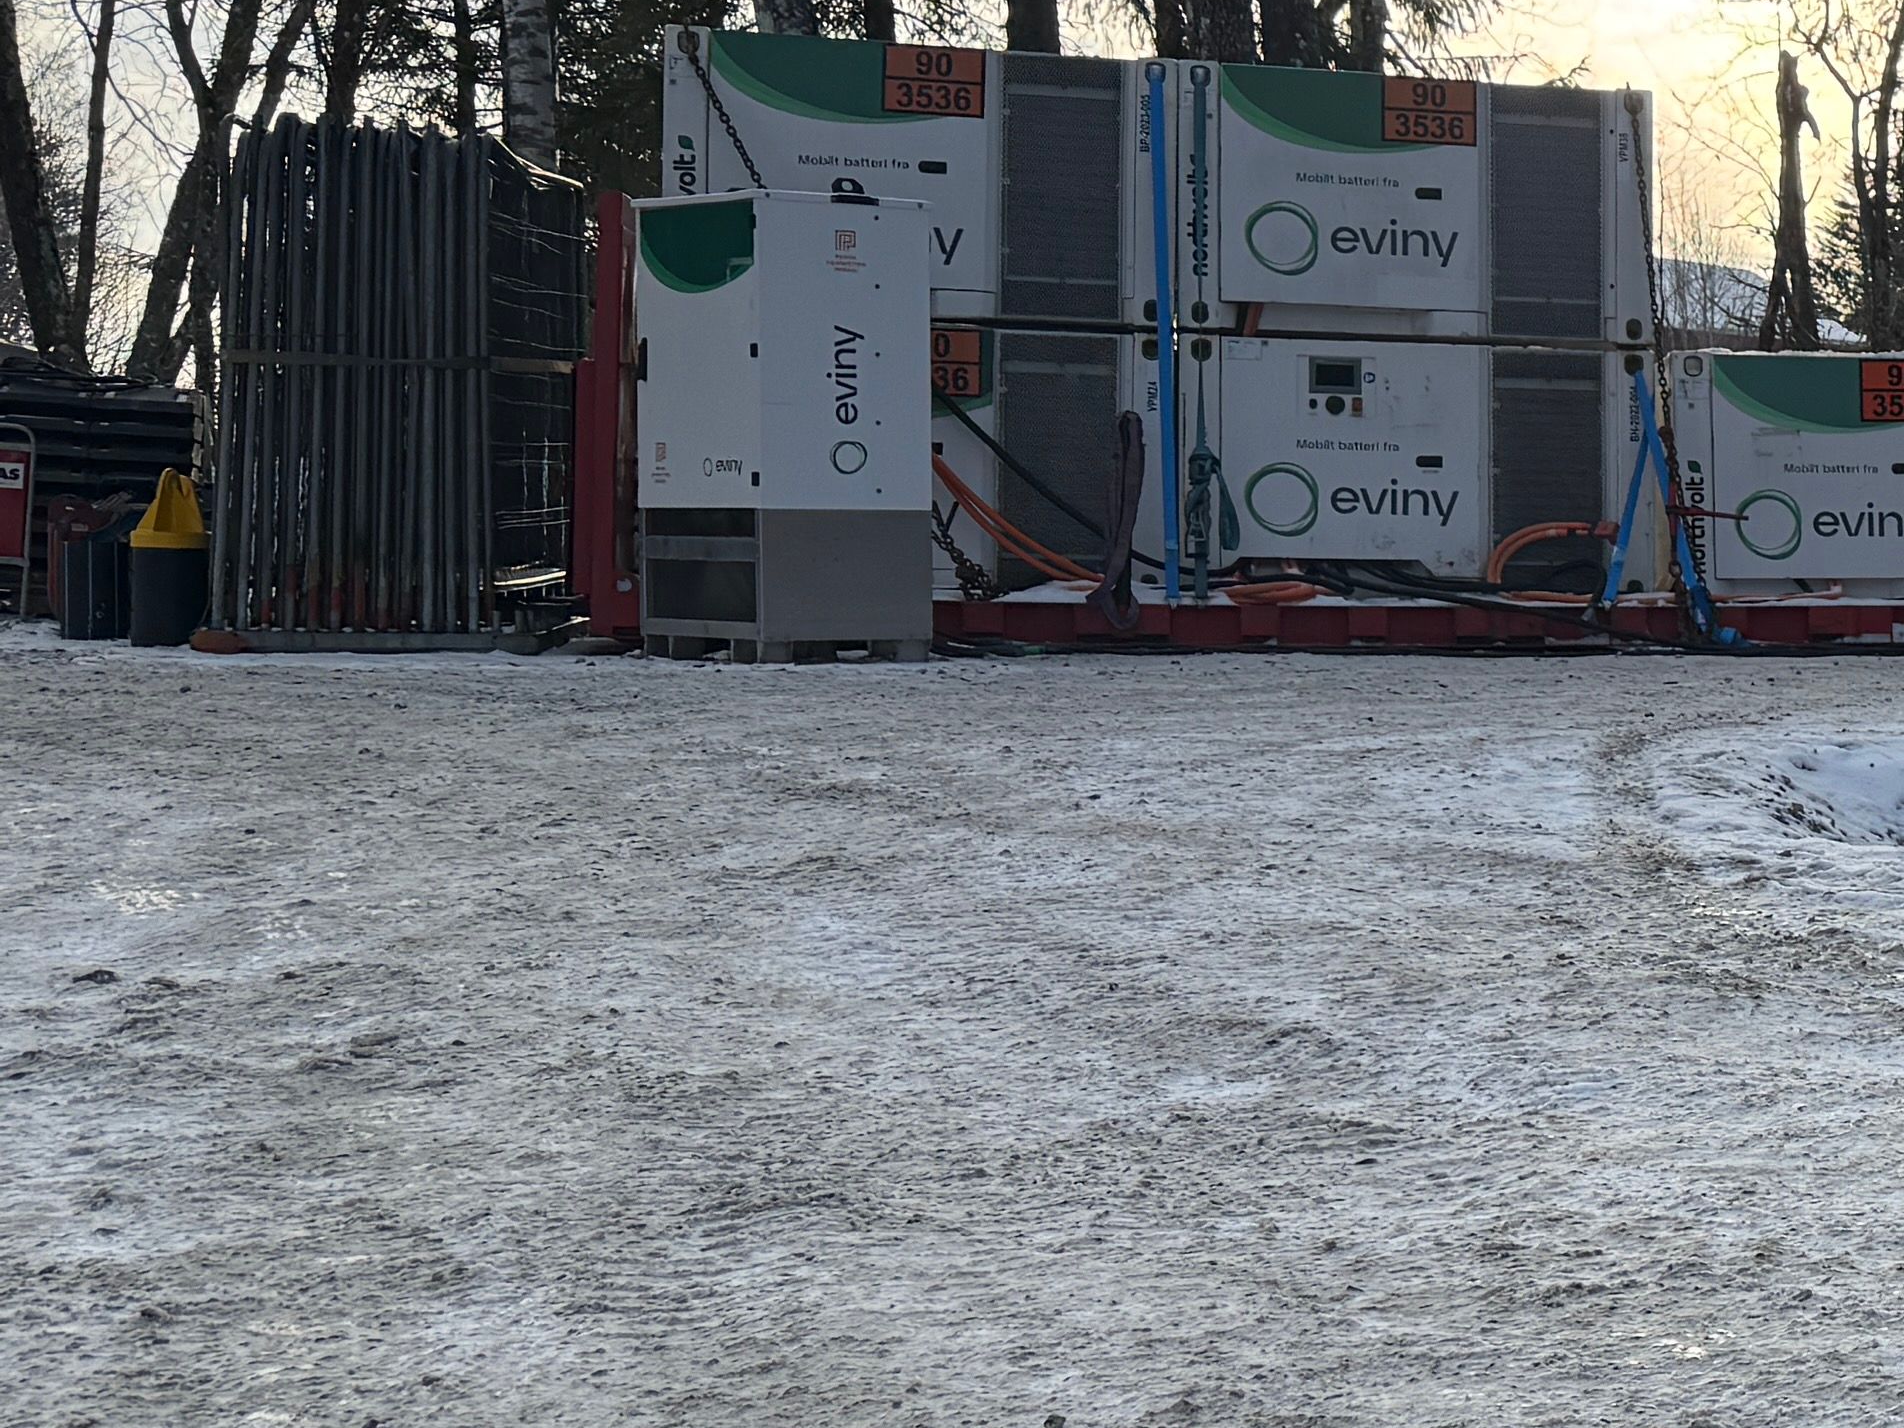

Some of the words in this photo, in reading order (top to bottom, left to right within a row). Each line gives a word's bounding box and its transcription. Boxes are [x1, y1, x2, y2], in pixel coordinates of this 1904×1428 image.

[915, 51, 953, 77] 90
[896, 83, 972, 111] 3536
[1412, 83, 1446, 107] 90
[1395, 114, 1464, 139] 3536
[798, 154, 839, 166] Mobilt
[844, 155, 887, 168] batteri
[891, 155, 909, 169] fra
[1296, 173, 1335, 184] Mobilt
[1338, 174, 1379, 187] batteri
[1383, 175, 1400, 187] fra
[1331, 219, 1458, 267] eviny
[826, 324, 865, 425] eviny
[1296, 439, 1335, 450] Mobilt
[1338, 440, 1379, 452] batteri
[1383, 441, 1399, 452] fra
[1863, 464, 1878, 473] fra
[1330, 478, 1459, 527] eviny
